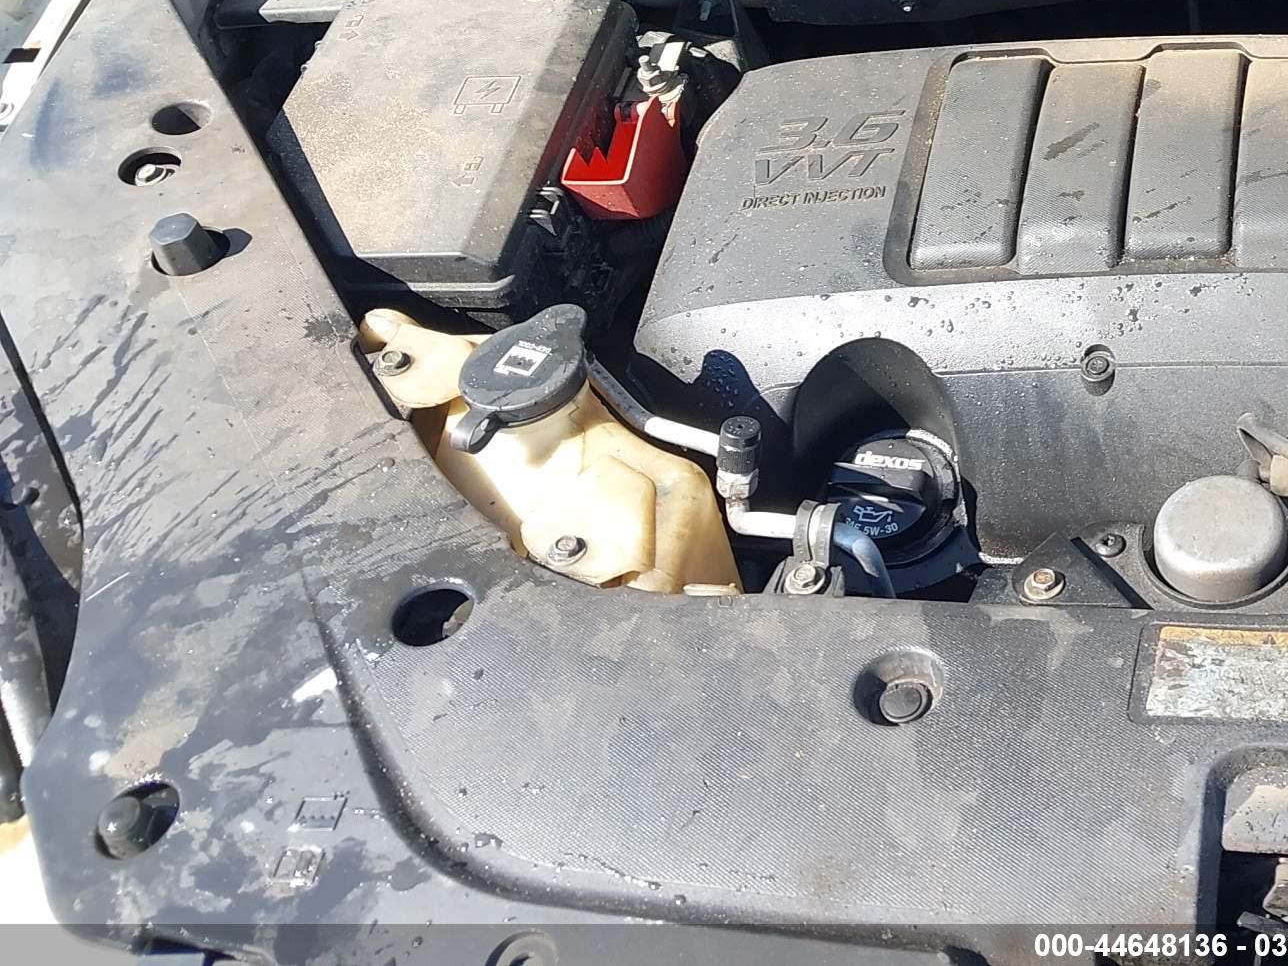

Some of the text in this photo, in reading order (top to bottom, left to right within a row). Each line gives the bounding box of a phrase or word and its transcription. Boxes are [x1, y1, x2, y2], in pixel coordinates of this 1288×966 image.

[760, 110, 906, 153] 3.6
[755, 148, 896, 185] VVT
[742, 185, 886, 210] DIRECT INJECTION
[854, 451, 926, 471] dexos
[864, 522, 899, 536] 5W-30
